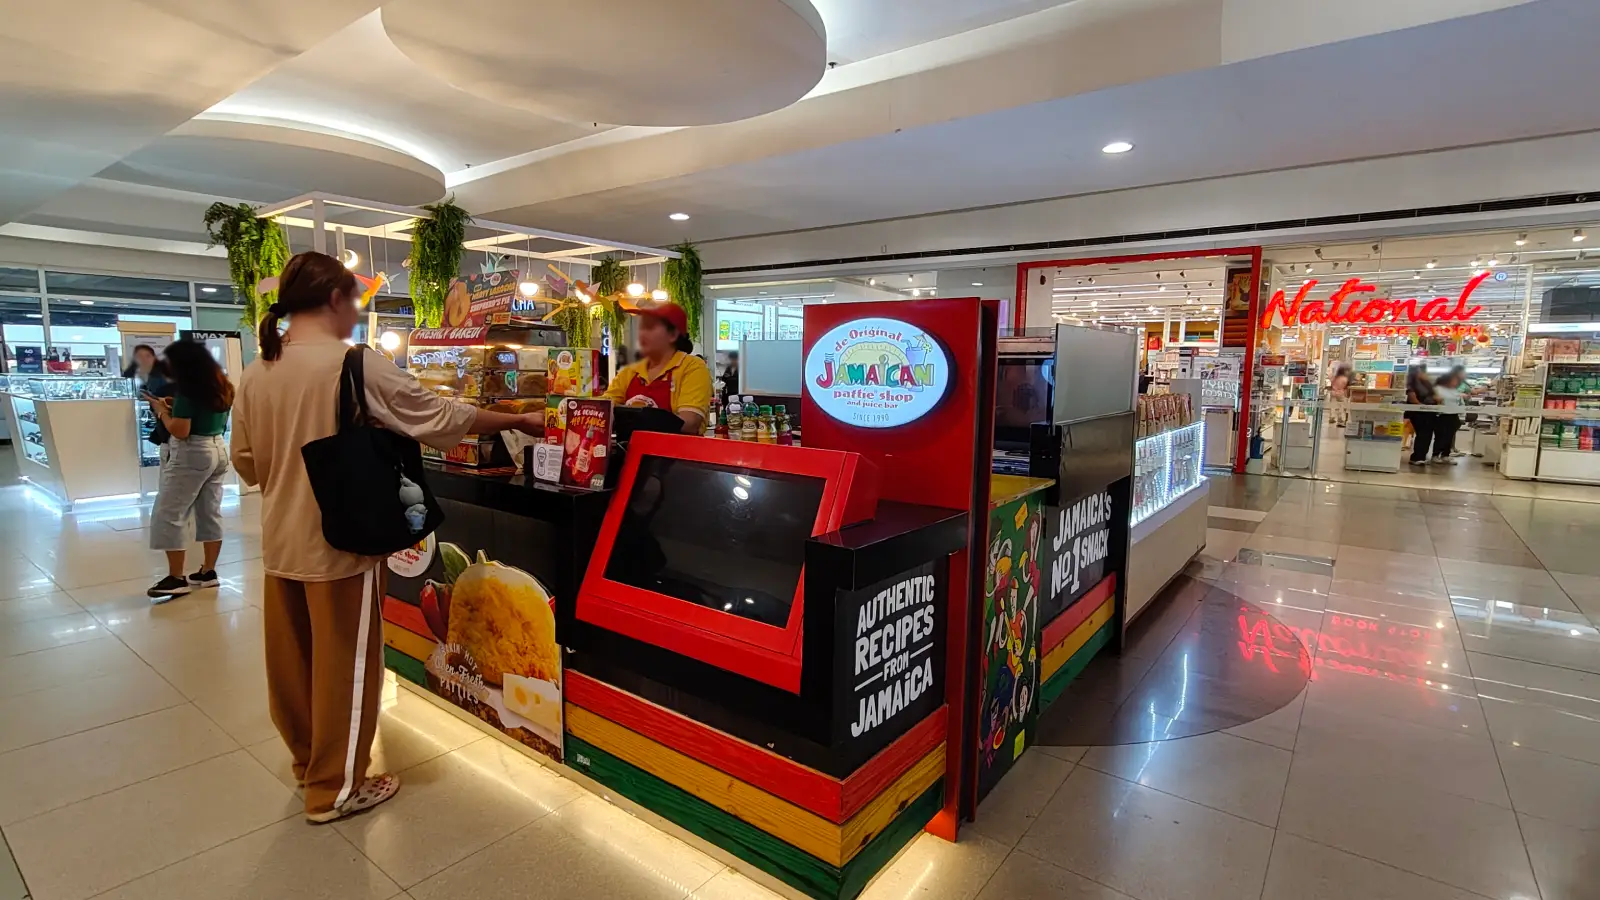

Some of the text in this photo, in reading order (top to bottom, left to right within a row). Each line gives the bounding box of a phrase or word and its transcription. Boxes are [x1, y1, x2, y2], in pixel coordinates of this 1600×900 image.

[1261, 270, 1491, 329] National
[192, 332, 227, 340] IMAX
[835, 325, 903, 352] de Original
[1359, 326, 1409, 337] BOOK
[862, 400, 883, 408] juice
[884, 400, 899, 409] bar
[880, 390, 914, 402] shop
[853, 412, 890, 422] SINCE 1990
[1053, 491, 1112, 552] JAMAICA'S
[1080, 528, 1110, 569] SNACK
[856, 574, 935, 638] AUTHENTIC
[854, 604, 935, 676] RECIPES
[883, 650, 910, 682] FROM
[440, 676, 479, 704] PATTIES
